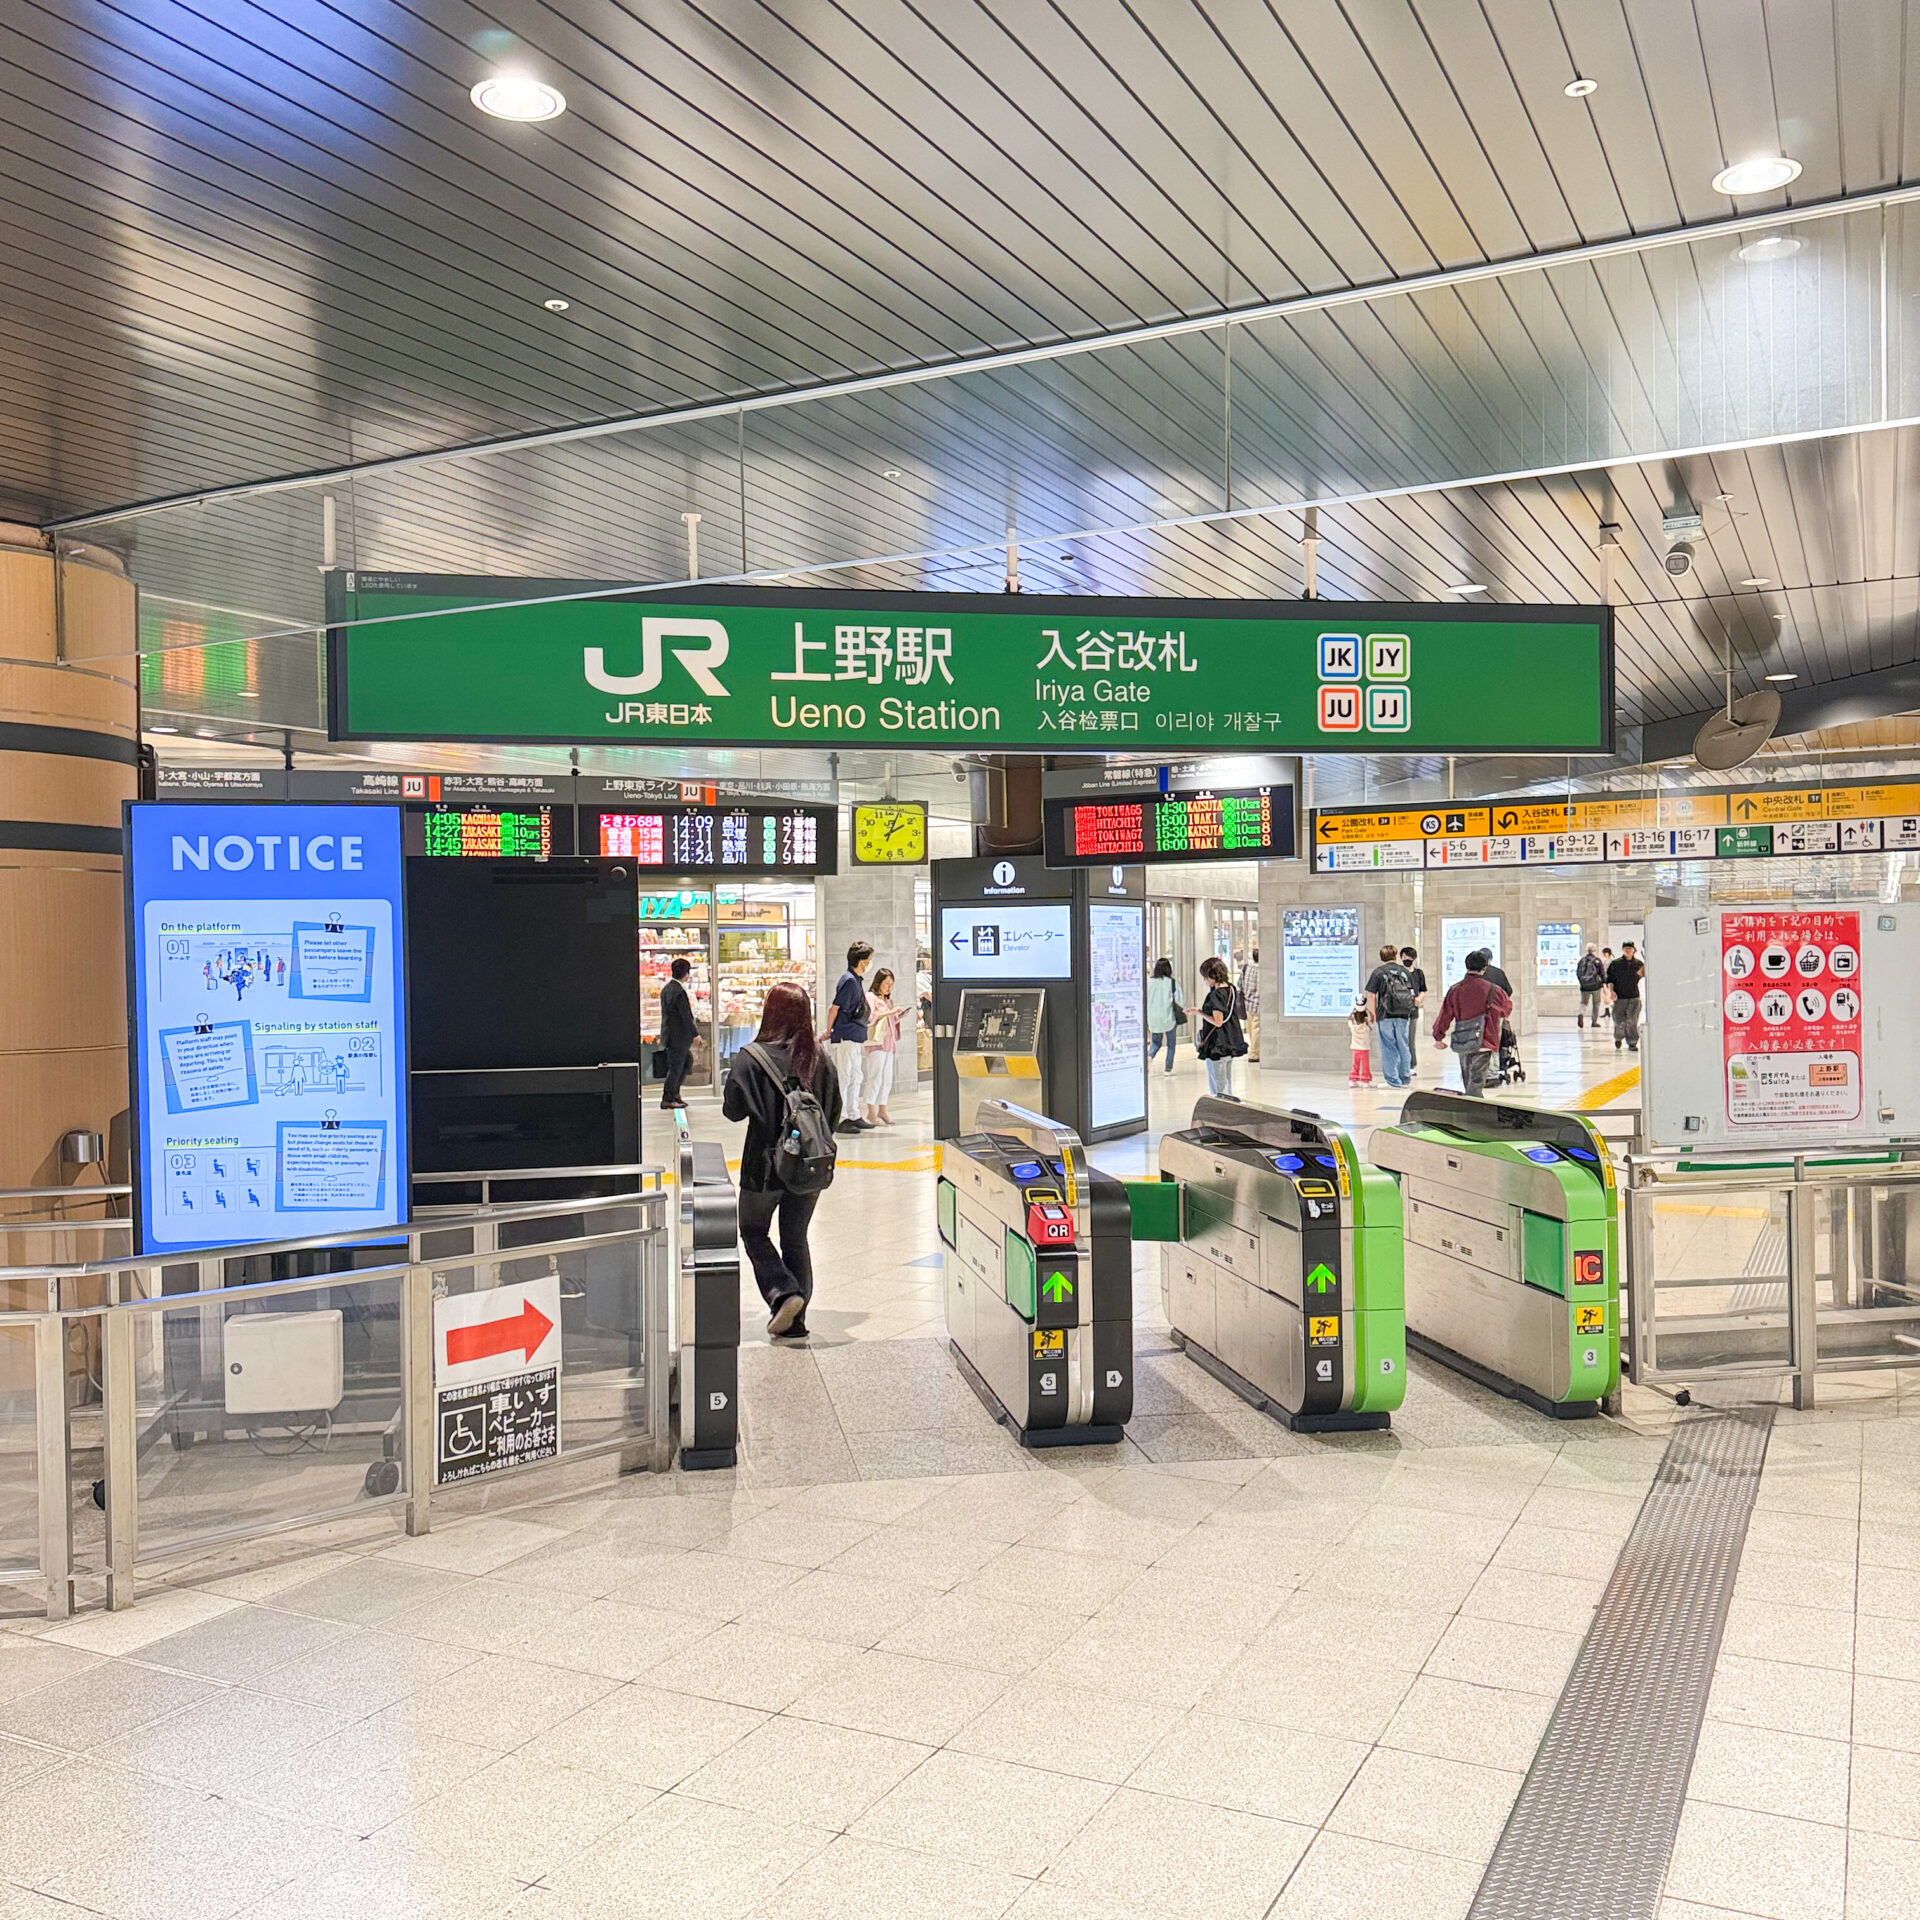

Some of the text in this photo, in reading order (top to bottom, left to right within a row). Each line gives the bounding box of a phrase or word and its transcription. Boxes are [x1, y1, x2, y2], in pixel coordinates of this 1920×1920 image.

[583, 616, 732, 696] JR
[770, 622, 955, 686] 上野駅
[1036, 629, 1198, 673] 入谷改札
[1327, 647, 1353, 668] JK
[1375, 648, 1401, 668] JY
[1035, 679, 1151, 706] Iriya Gate
[605, 702, 713, 725] JR東日本
[770, 695, 1001, 731] Ueno Station
[1327, 699, 1353, 719] JU
[1377, 699, 1399, 719] JJ
[1037, 710, 1139, 732] 入谷检票口
[1155, 711, 1283, 733] 이리야 개찰구
[363, 775, 399, 787] 高崎線
[405, 781, 421, 791] JU
[351, 786, 399, 795] Takasaki Line
[684, 784, 698, 796] JU
[1155, 801, 1187, 814] 14:30
[1261, 796, 1270, 808] 8
[1763, 794, 1804, 805] 中央改札
[424, 813, 461, 825] 14:05
[541, 814, 550, 825] 5
[1155, 814, 1187, 827] 15:00
[1261, 809, 1270, 821] 8
[1523, 808, 1560, 818] 入谷改札
[600, 815, 663, 828] ときわ68号
[673, 815, 714, 828] 14:09
[722, 816, 747, 828] 品川
[1426, 820, 1436, 829] KS
[425, 826, 461, 838] 14:27
[541, 827, 550, 838] 5
[673, 828, 712, 841] 14:11
[1156, 826, 1188, 839] 15:30
[1261, 822, 1271, 835] 8
[425, 838, 461, 850] 14:45
[541, 839, 550, 850] 5
[673, 840, 713, 852] 14:21
[1156, 839, 1188, 852] 16:00
[1261, 834, 1271, 847] 8
[1528, 836, 1536, 848] 8
[172, 835, 364, 872] NOTICE
[673, 852, 714, 865] 14:24
[722, 852, 747, 865] 品川
[984, 886, 1026, 895] Information
[161, 922, 241, 933] On the platform
[1292, 919, 1351, 928] CRAFTERS
[1003, 930, 1065, 943] エレベーター
[1292, 927, 1351, 937] MARKET
[166, 939, 190, 955] 01
[1003, 944, 1030, 952] Elevator
[255, 1020, 379, 1032] Signaling by station staff
[348, 1037, 375, 1052] 02
[1818, 1065, 1840, 1073] 上野駅
[166, 1136, 239, 1147] Priority seating
[171, 1154, 197, 1169] 03
[1048, 1225, 1069, 1237] QR
[1574, 1255, 1601, 1282] IC
[1587, 1351, 1595, 1362] 3
[1321, 1363, 1328, 1373] 4
[1383, 1361, 1391, 1371] 3
[1045, 1376, 1053, 1387] 5
[1109, 1373, 1117, 1384] 4
[488, 1382, 556, 1414] 車いす
[713, 1394, 722, 1405] 5
[488, 1407, 556, 1433] ベビーカー
[488, 1424, 556, 1457] ご利用のお客さま
